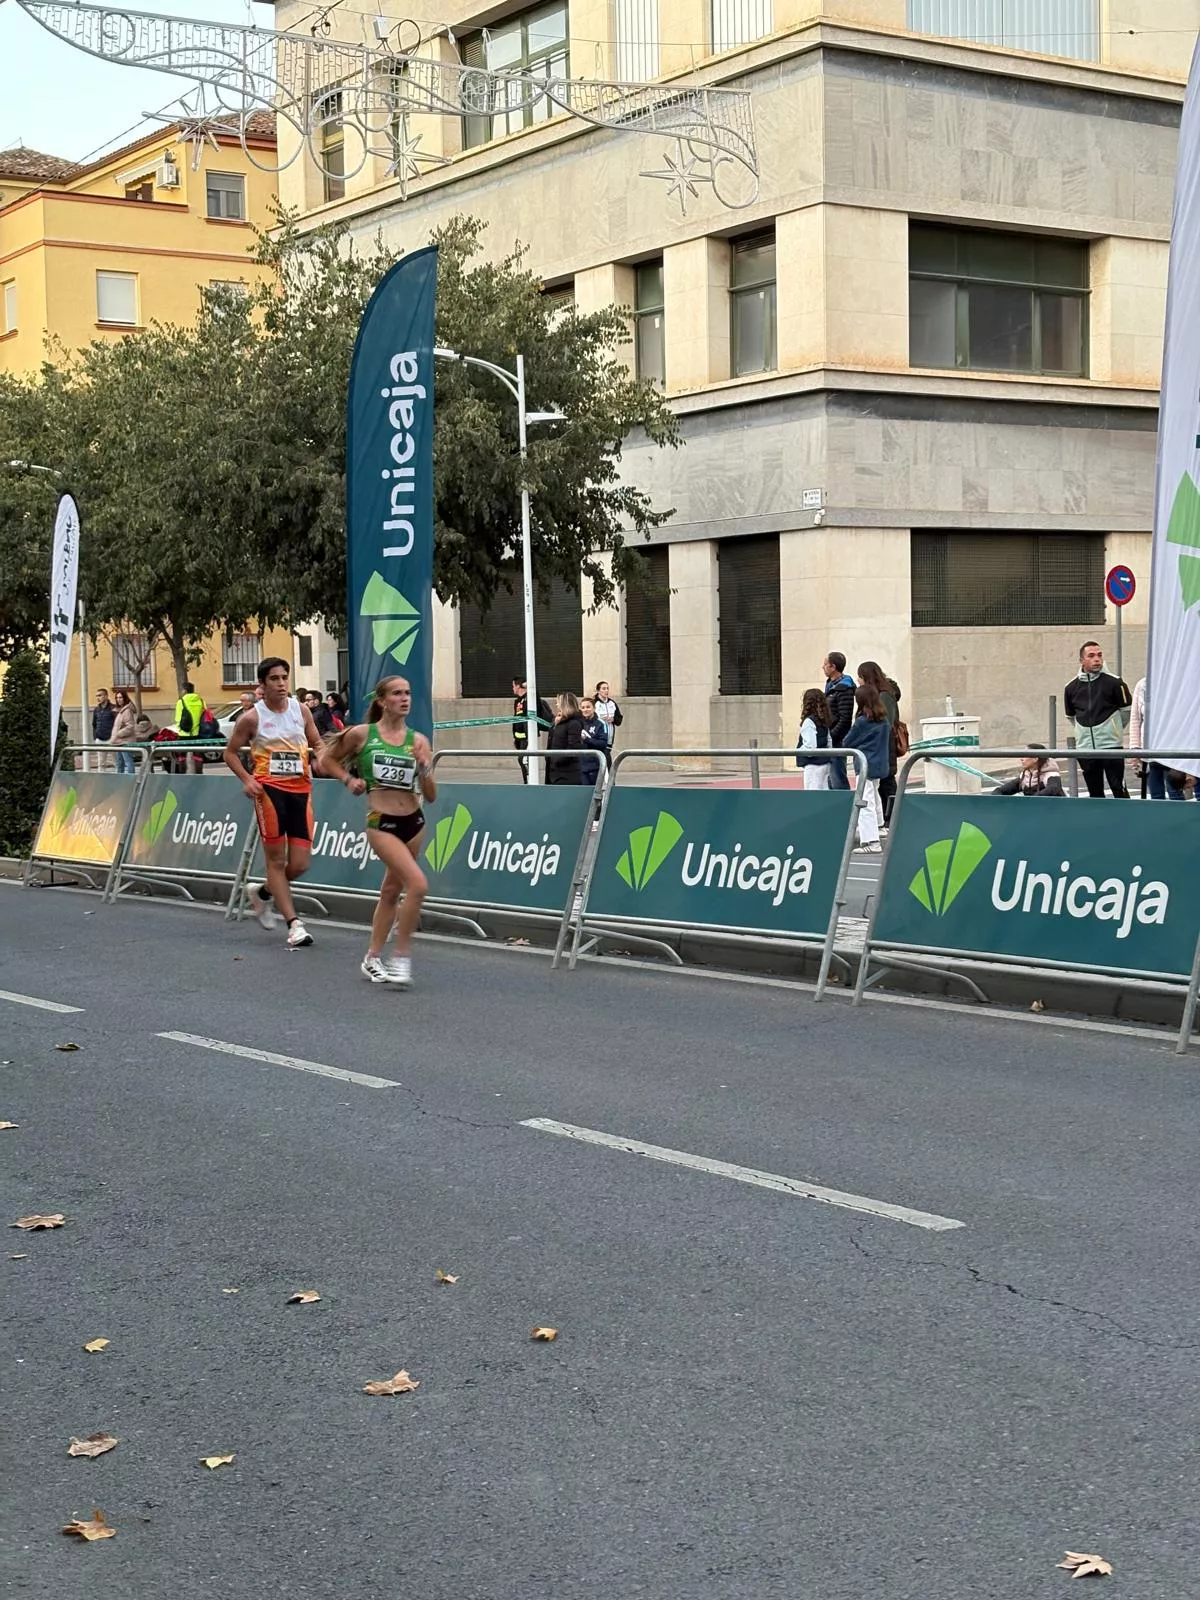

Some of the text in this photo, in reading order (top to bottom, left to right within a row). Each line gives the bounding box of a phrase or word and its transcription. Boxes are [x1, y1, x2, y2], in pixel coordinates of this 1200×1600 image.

[381, 351, 426, 557] Unicaja
[381, 767, 406, 781] 239
[172, 812, 238, 855] Unicaja
[467, 831, 561, 886] Unicaja
[681, 842, 813, 906] Unicaja
[991, 859, 1170, 939] Unicaja
